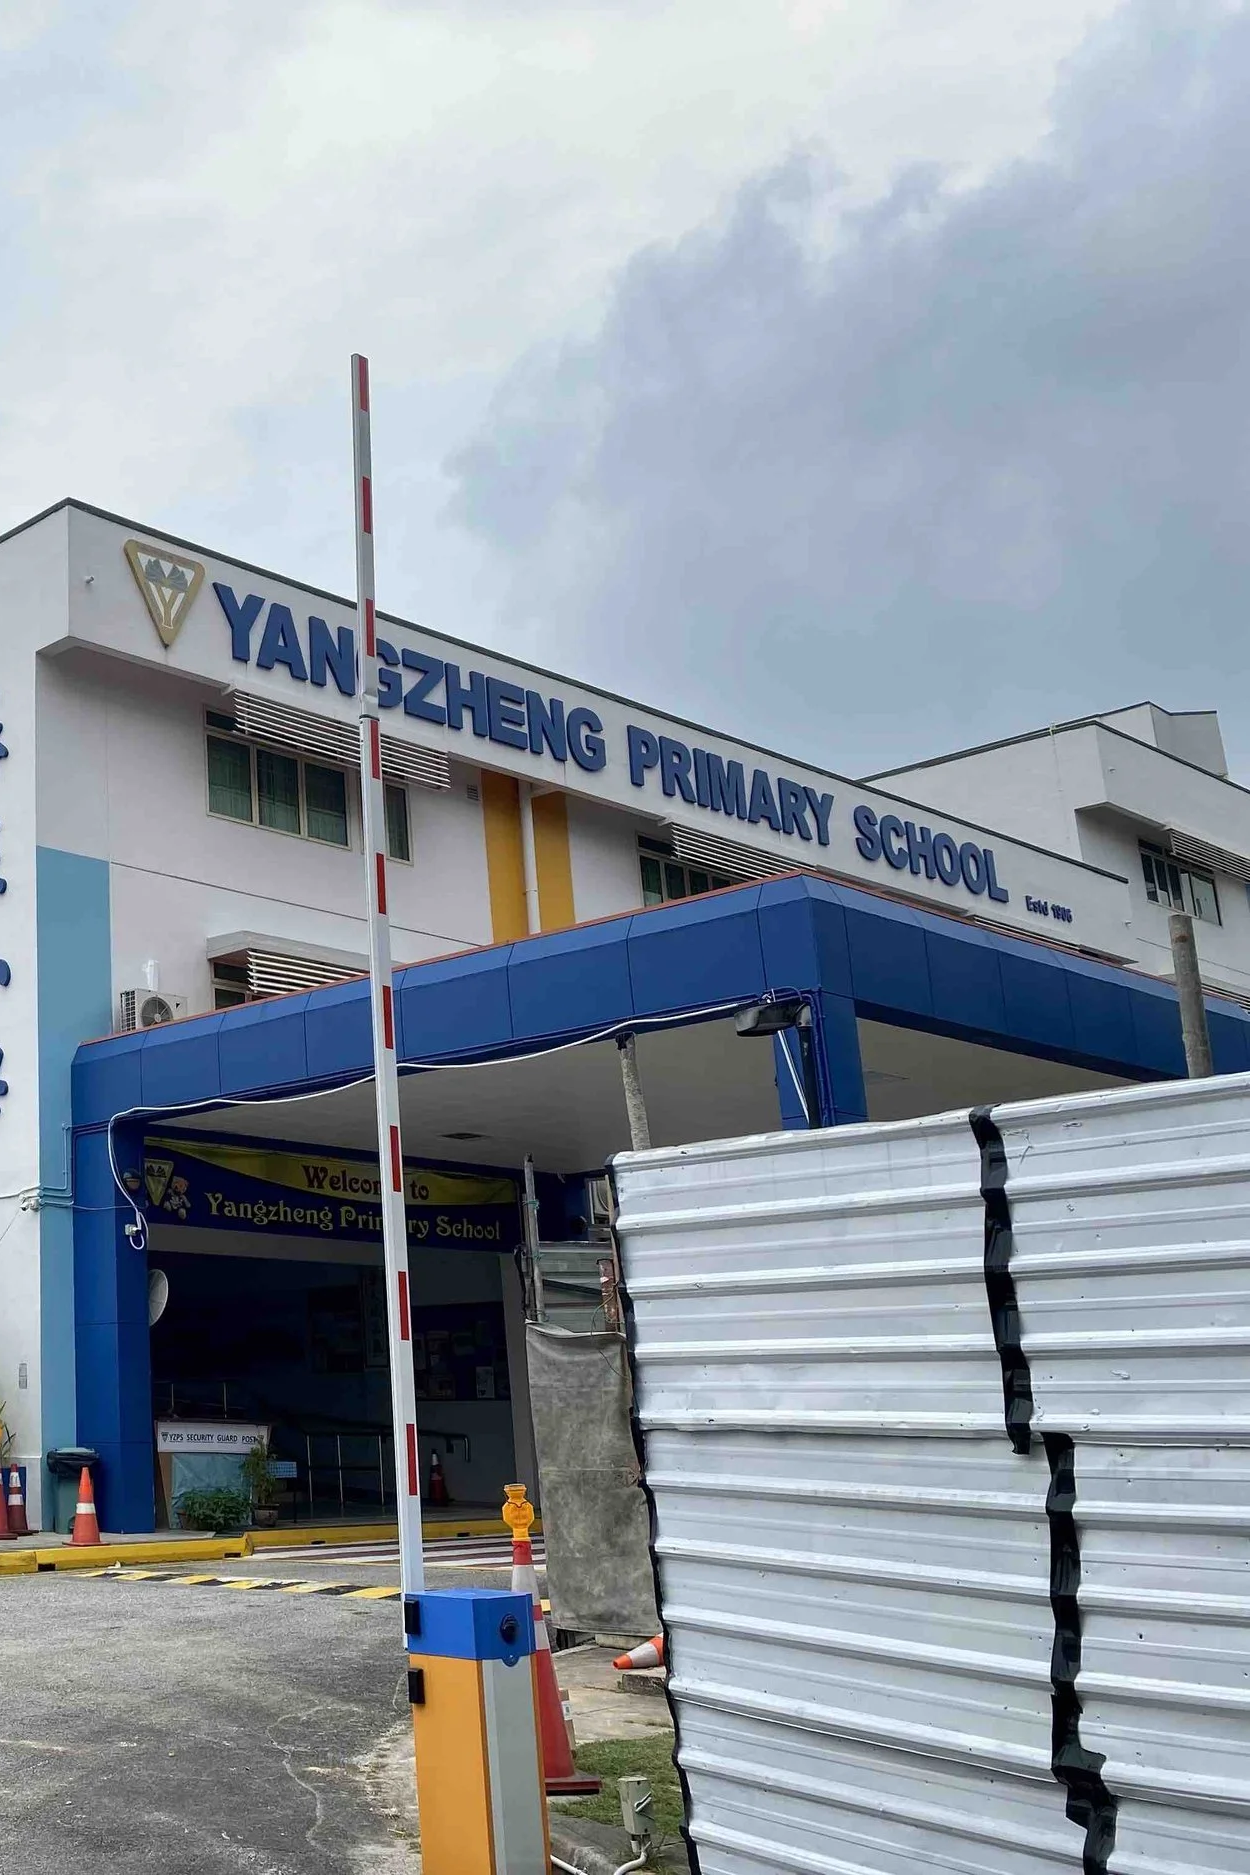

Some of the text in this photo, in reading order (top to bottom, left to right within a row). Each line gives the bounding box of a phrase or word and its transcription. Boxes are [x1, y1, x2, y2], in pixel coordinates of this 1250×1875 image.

[213, 581, 1010, 903] YANGZHENG PRIMARY SCHOOL
[302, 1165, 430, 1200] Welco to
[204, 1192, 501, 1240] Yangzheng Priry School
[186, 1433, 215, 1442] SECURITY
[217, 1434, 238, 1443] GUARD
